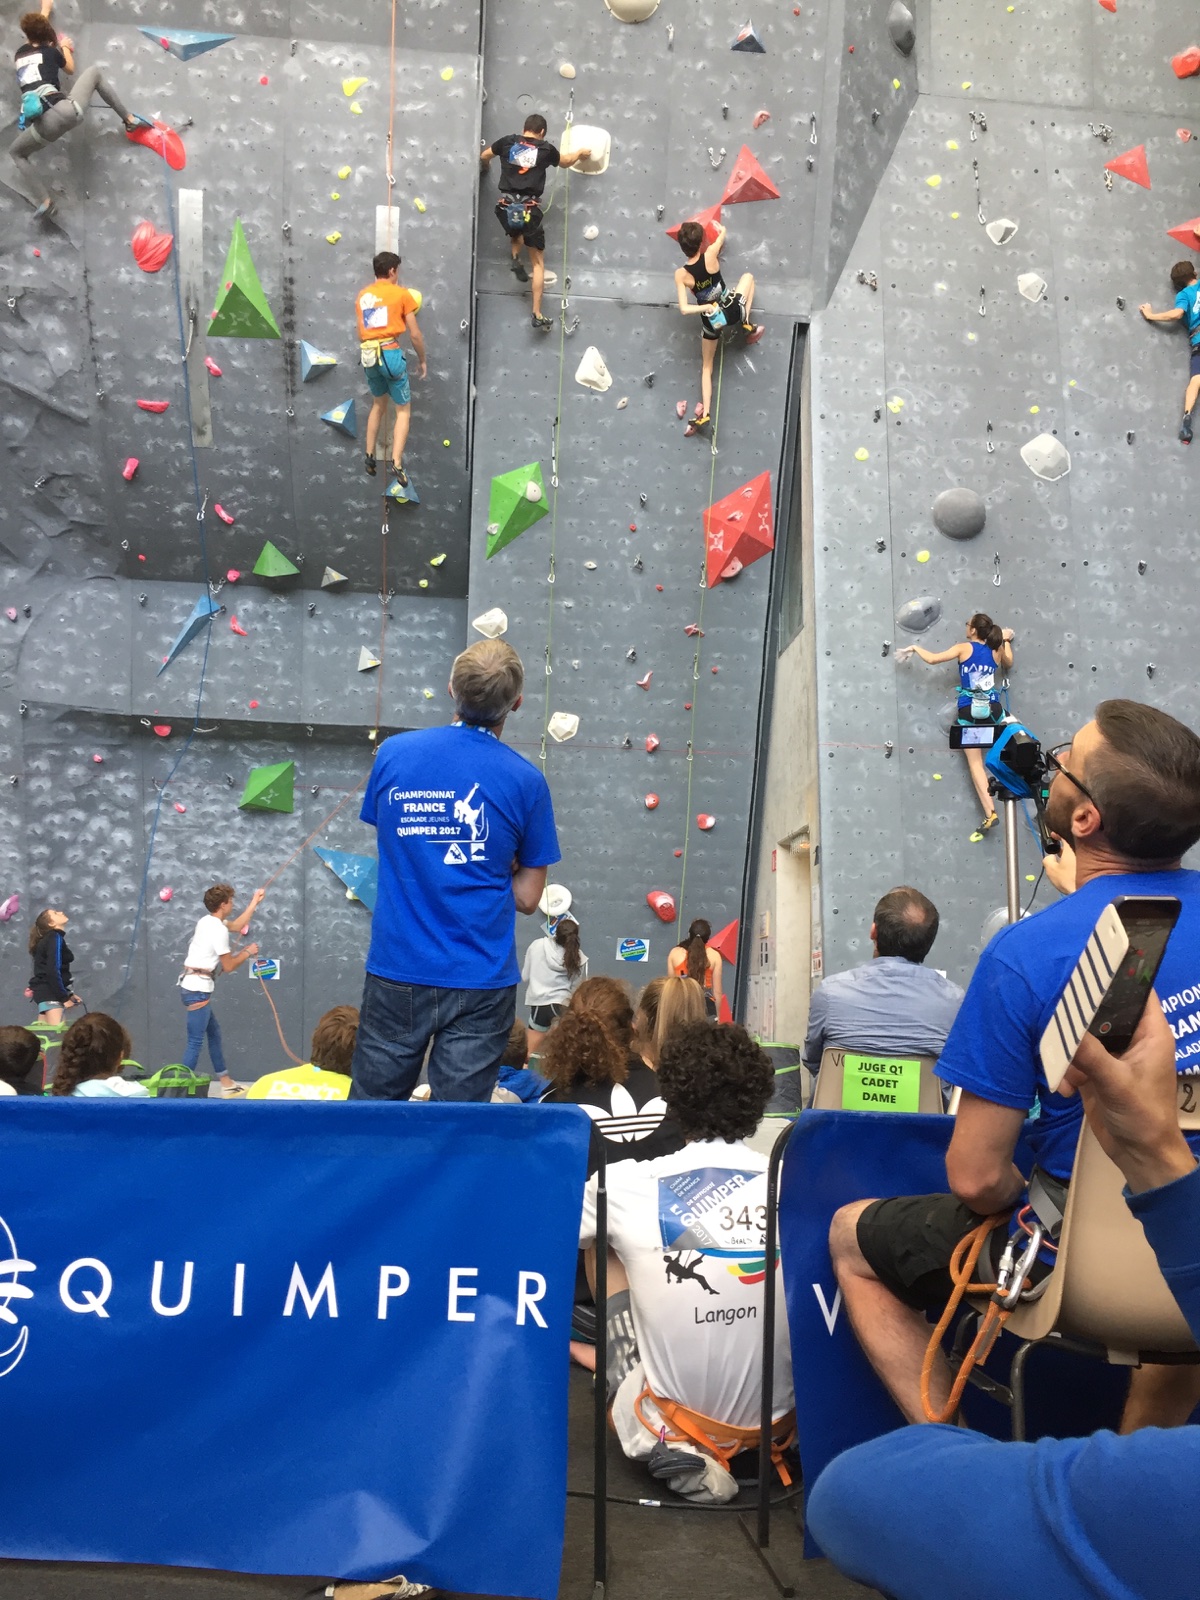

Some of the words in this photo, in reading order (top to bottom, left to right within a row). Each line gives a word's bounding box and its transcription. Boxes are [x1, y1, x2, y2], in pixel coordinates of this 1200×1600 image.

[394, 790, 456, 801] CHAMPIONNAT
[403, 802, 446, 813] FRANCE
[396, 826, 437, 837] QUIMPER
[439, 826, 461, 835] 2017
[858, 1062, 886, 1073] JUGE
[889, 1064, 903, 1075] Q1
[861, 1077, 899, 1089] CADET
[862, 1092, 896, 1104] DAME
[680, 1174, 750, 1227] QUIMPER
[719, 1205, 767, 1231] 343
[692, 1224, 713, 1246] 2017
[59, 1257, 549, 1329] QUIMPER
[695, 1306, 757, 1326] Langon
[812, 1283, 843, 1336] V
